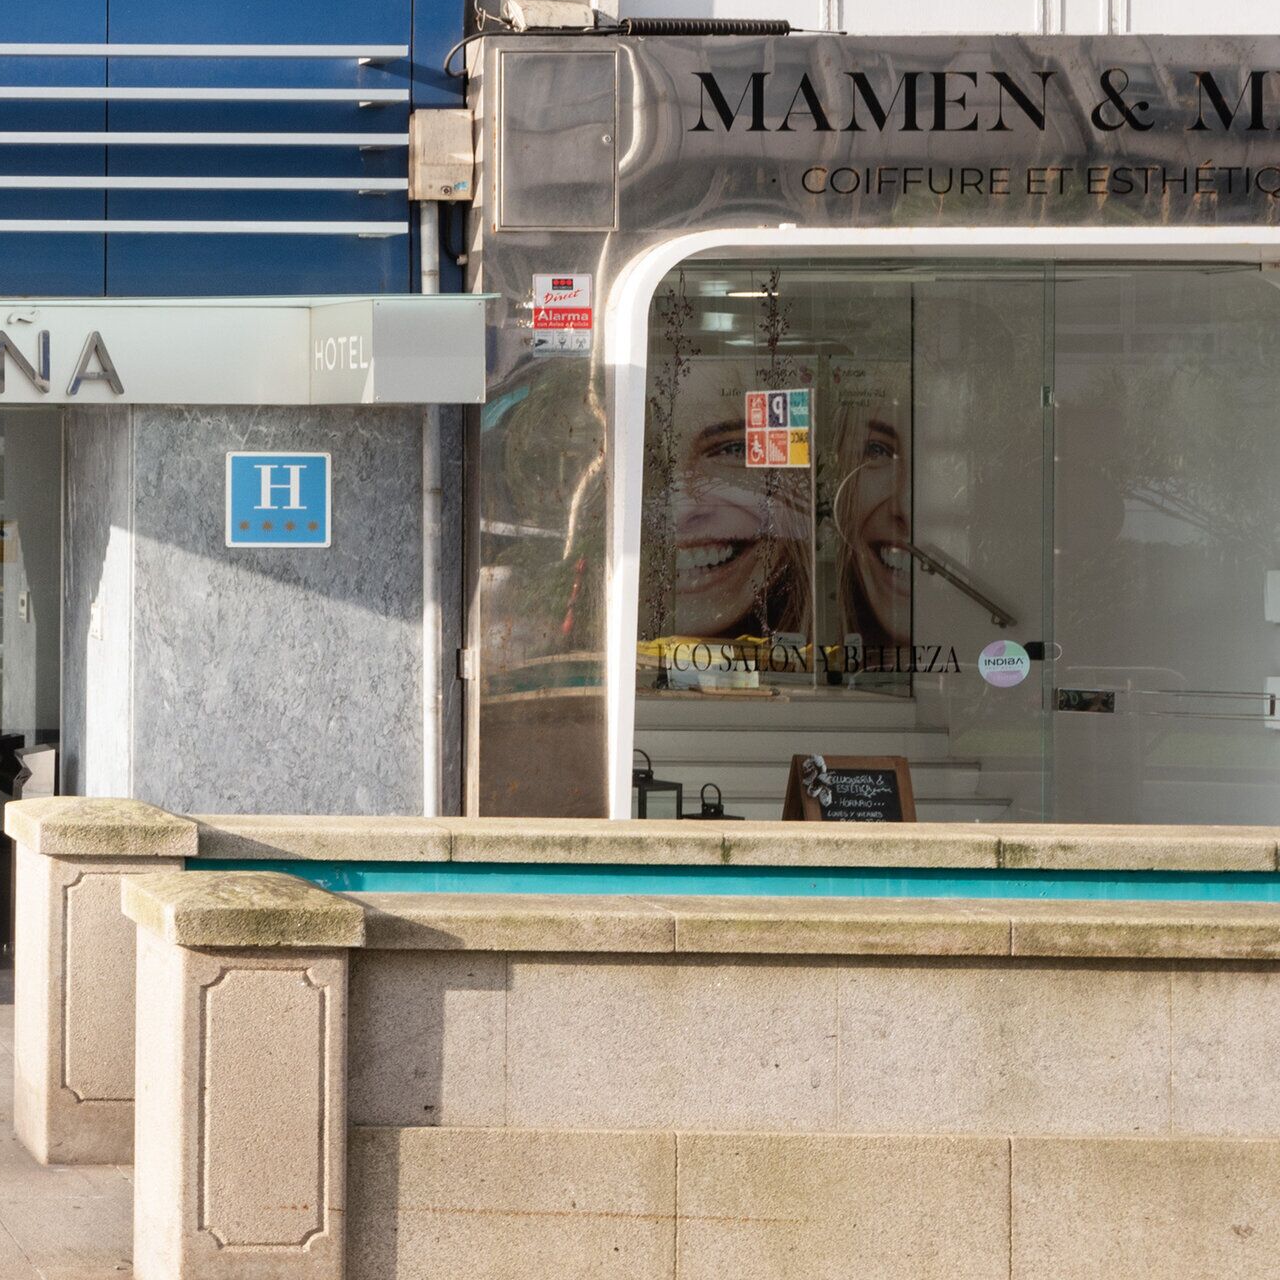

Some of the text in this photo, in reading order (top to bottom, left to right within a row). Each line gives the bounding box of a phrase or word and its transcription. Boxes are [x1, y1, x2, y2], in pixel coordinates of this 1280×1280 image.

[688, 68, 1280, 132] MAMEN & M
[801, 159, 1280, 198] COIFFURE ET ESTHÉTIQ
[537, 310, 589, 321] Alarma
[314, 335, 369, 370] HOTEL
[253, 464, 308, 510] H
[815, 644, 832, 673] Y
[843, 644, 963, 674] BELLEZA
